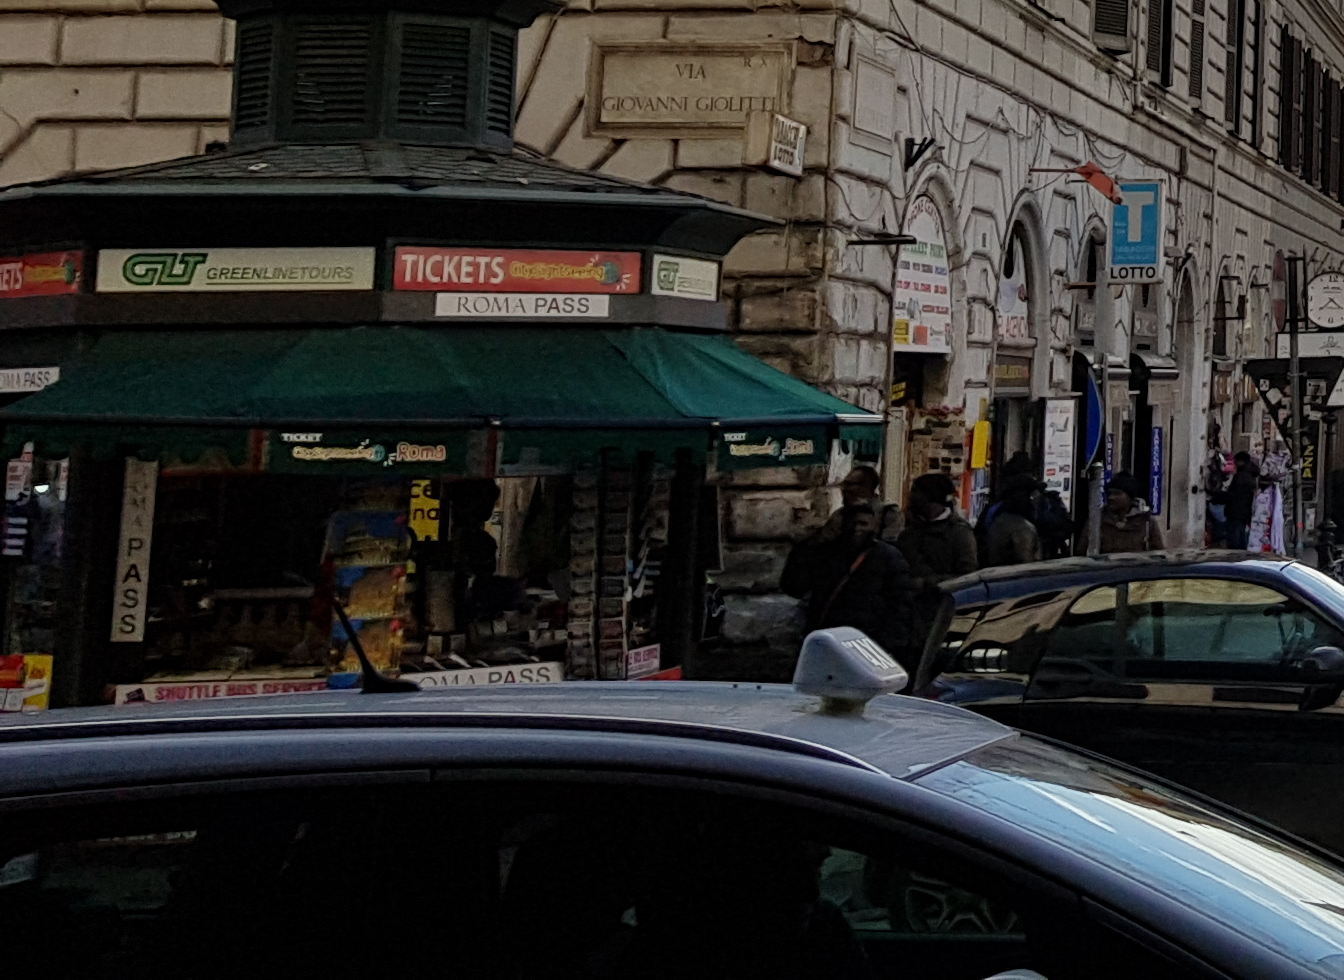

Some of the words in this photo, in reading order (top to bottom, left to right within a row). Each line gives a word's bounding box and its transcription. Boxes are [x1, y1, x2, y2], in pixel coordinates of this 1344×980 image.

[675, 63, 707, 79] VIA
[602, 95, 689, 113] GIOVANNI
[696, 95, 776, 113] GIOLITTI
[206, 266, 354, 281] GREENLINETOURS
[401, 253, 506, 285] TICKETS
[1110, 266, 1157, 280] LOTTO
[457, 296, 527, 314] ROMA
[534, 296, 591, 314] PASS
[24, 370, 51, 387] PASS
[281, 433, 323, 442] TICKET
[396, 441, 447, 462] Roma
[1302, 445, 1314, 479] ZZA
[119, 537, 144, 635] PASS
[154, 685, 222, 702] SHUTTLE
